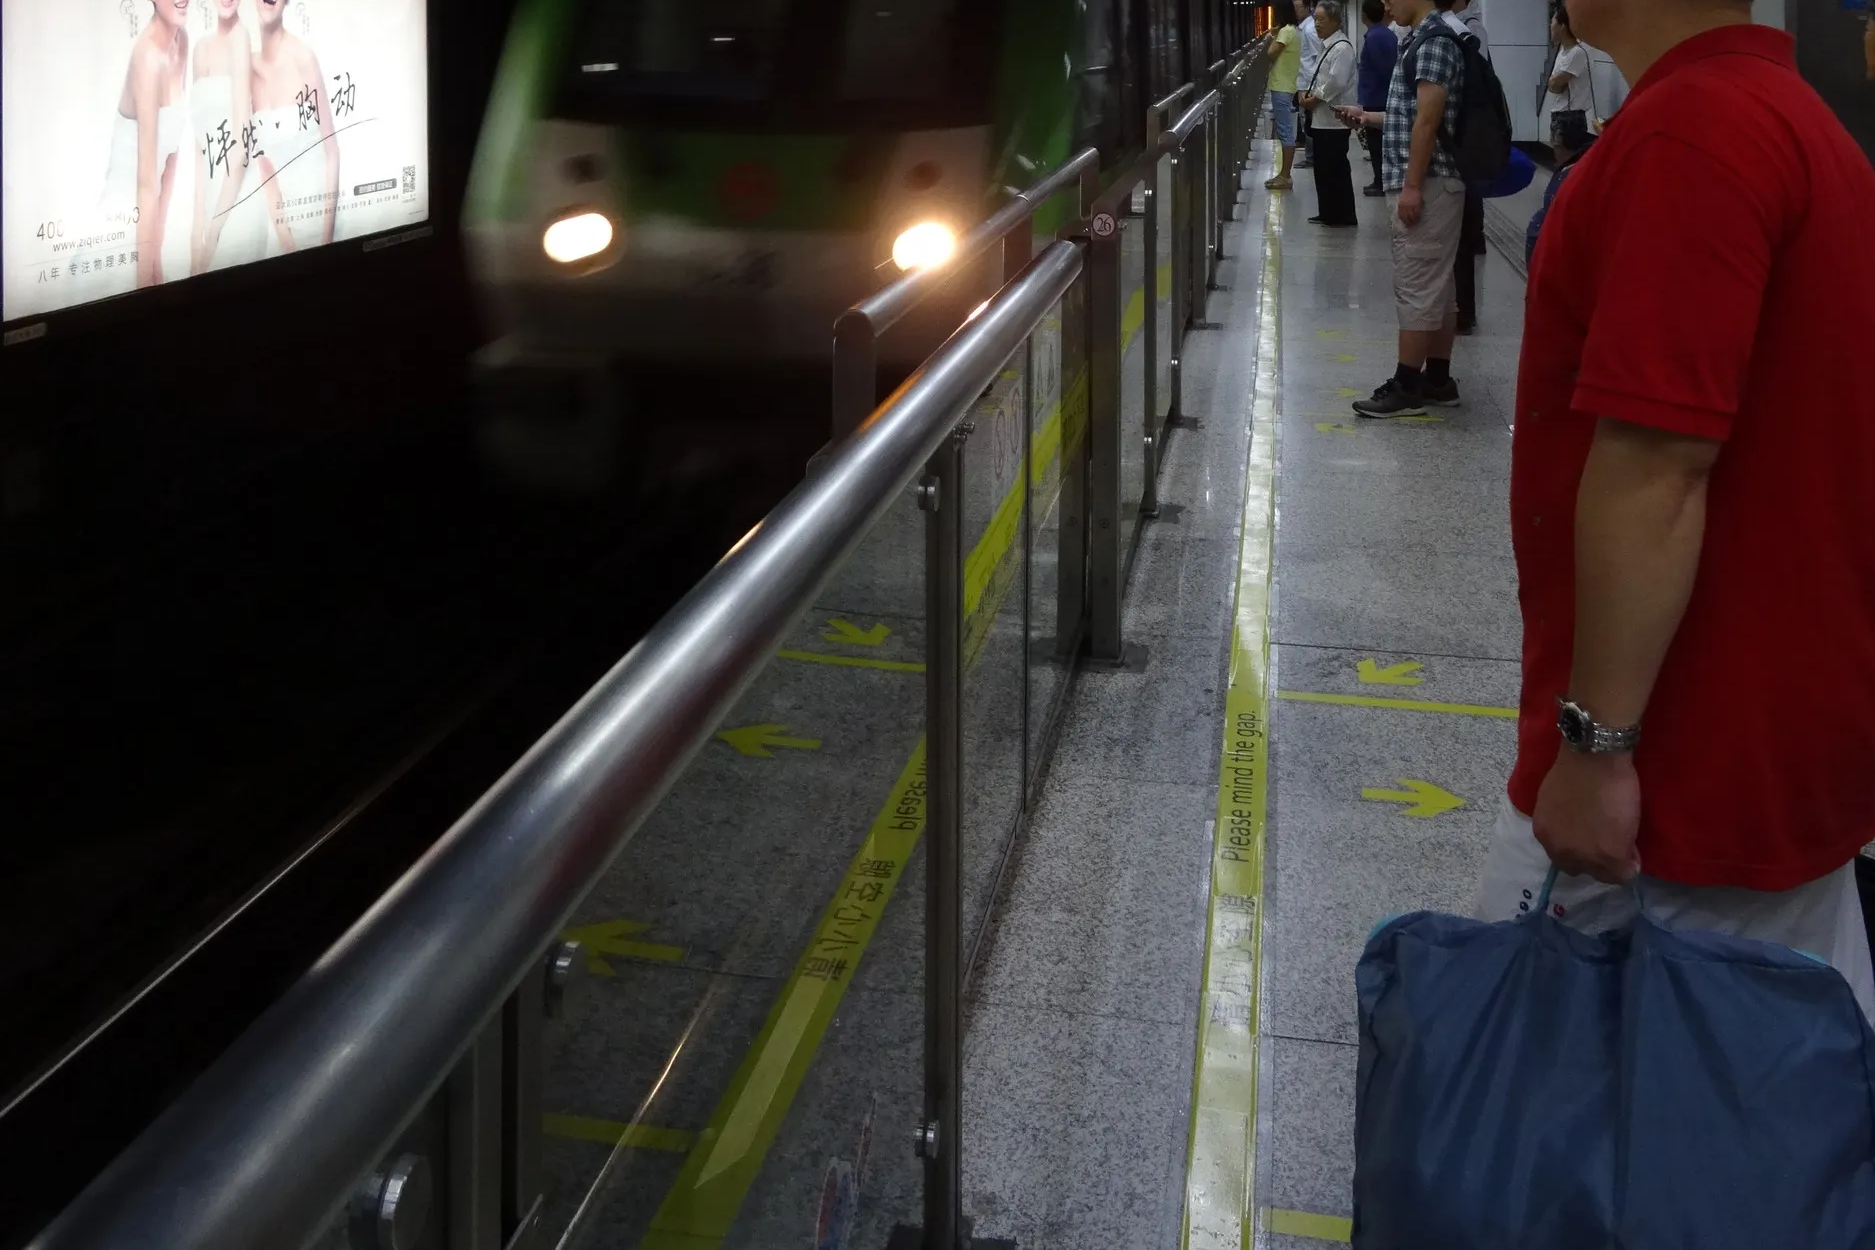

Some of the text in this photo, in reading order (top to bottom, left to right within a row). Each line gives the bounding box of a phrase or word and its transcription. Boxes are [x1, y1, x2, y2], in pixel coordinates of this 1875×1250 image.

[1096, 216, 1112, 231] 26
[38, 267, 60, 284] 八年
[1236, 710, 1263, 739] gap.
[1227, 740, 1255, 763] the
[1225, 766, 1253, 805] mind
[1220, 808, 1252, 863] Please
